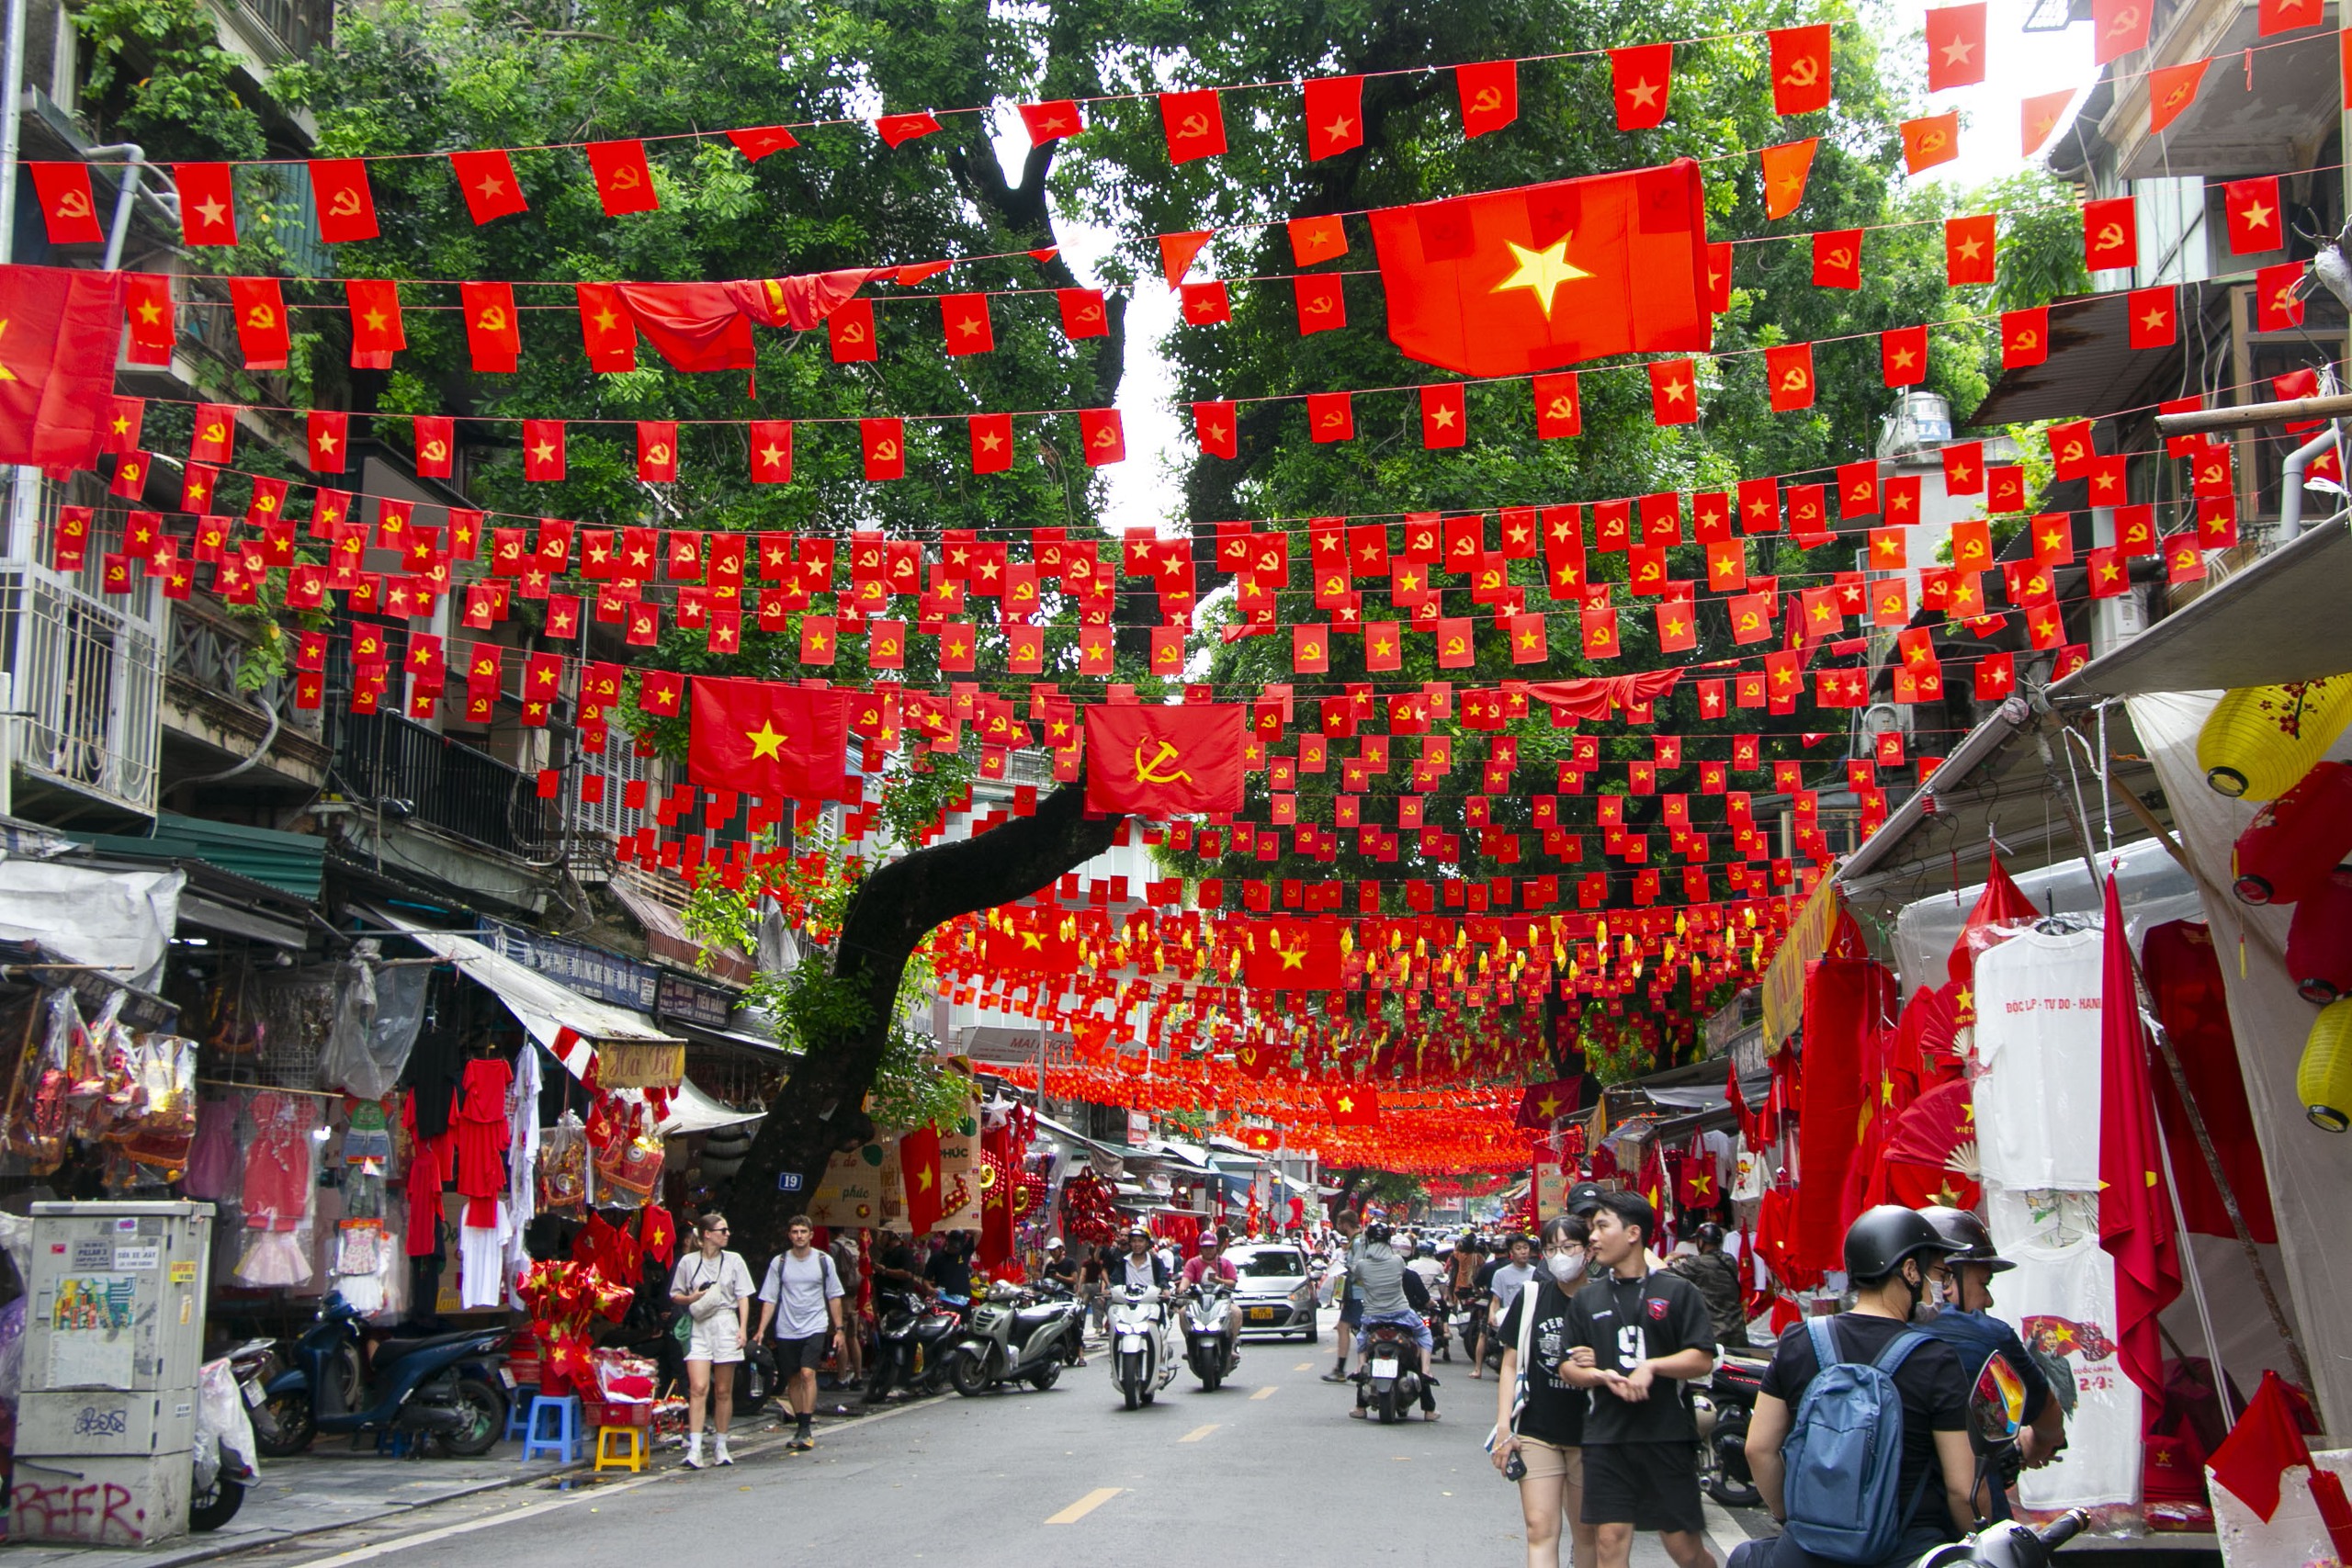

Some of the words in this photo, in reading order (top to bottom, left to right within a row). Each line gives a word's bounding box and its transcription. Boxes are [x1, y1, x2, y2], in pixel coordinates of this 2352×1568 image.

[2058, 998, 2071, 1010] DO
[1010, 1038, 1036, 1049] MAI
[784, 1175, 797, 1188] 19
[842, 1184, 869, 1202] phúc
[1538, 1316, 1564, 1333] TER
[1618, 1325, 1646, 1369] 9
